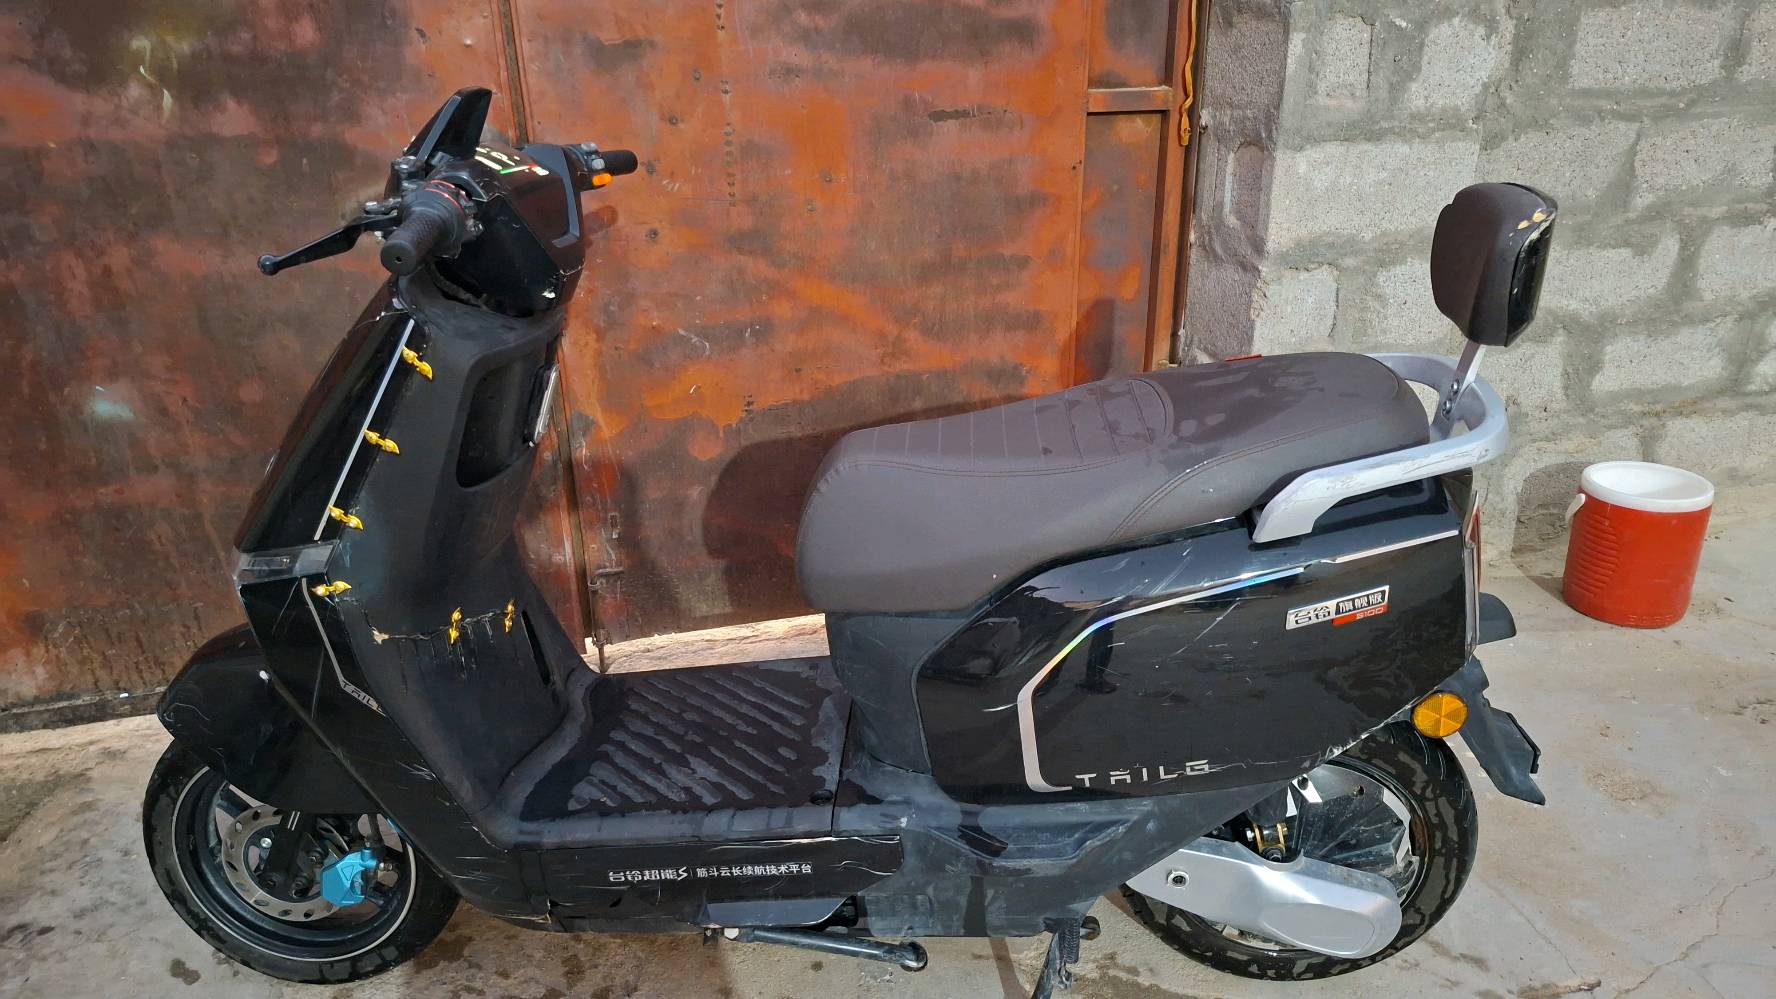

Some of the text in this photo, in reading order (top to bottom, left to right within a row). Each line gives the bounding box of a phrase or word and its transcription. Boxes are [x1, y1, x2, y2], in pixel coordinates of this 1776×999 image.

[1338, 592, 1384, 613] 旗舰版
[1074, 759, 1210, 787] TAILG
[695, 863, 812, 878] 筋斗云长续航技术平台
